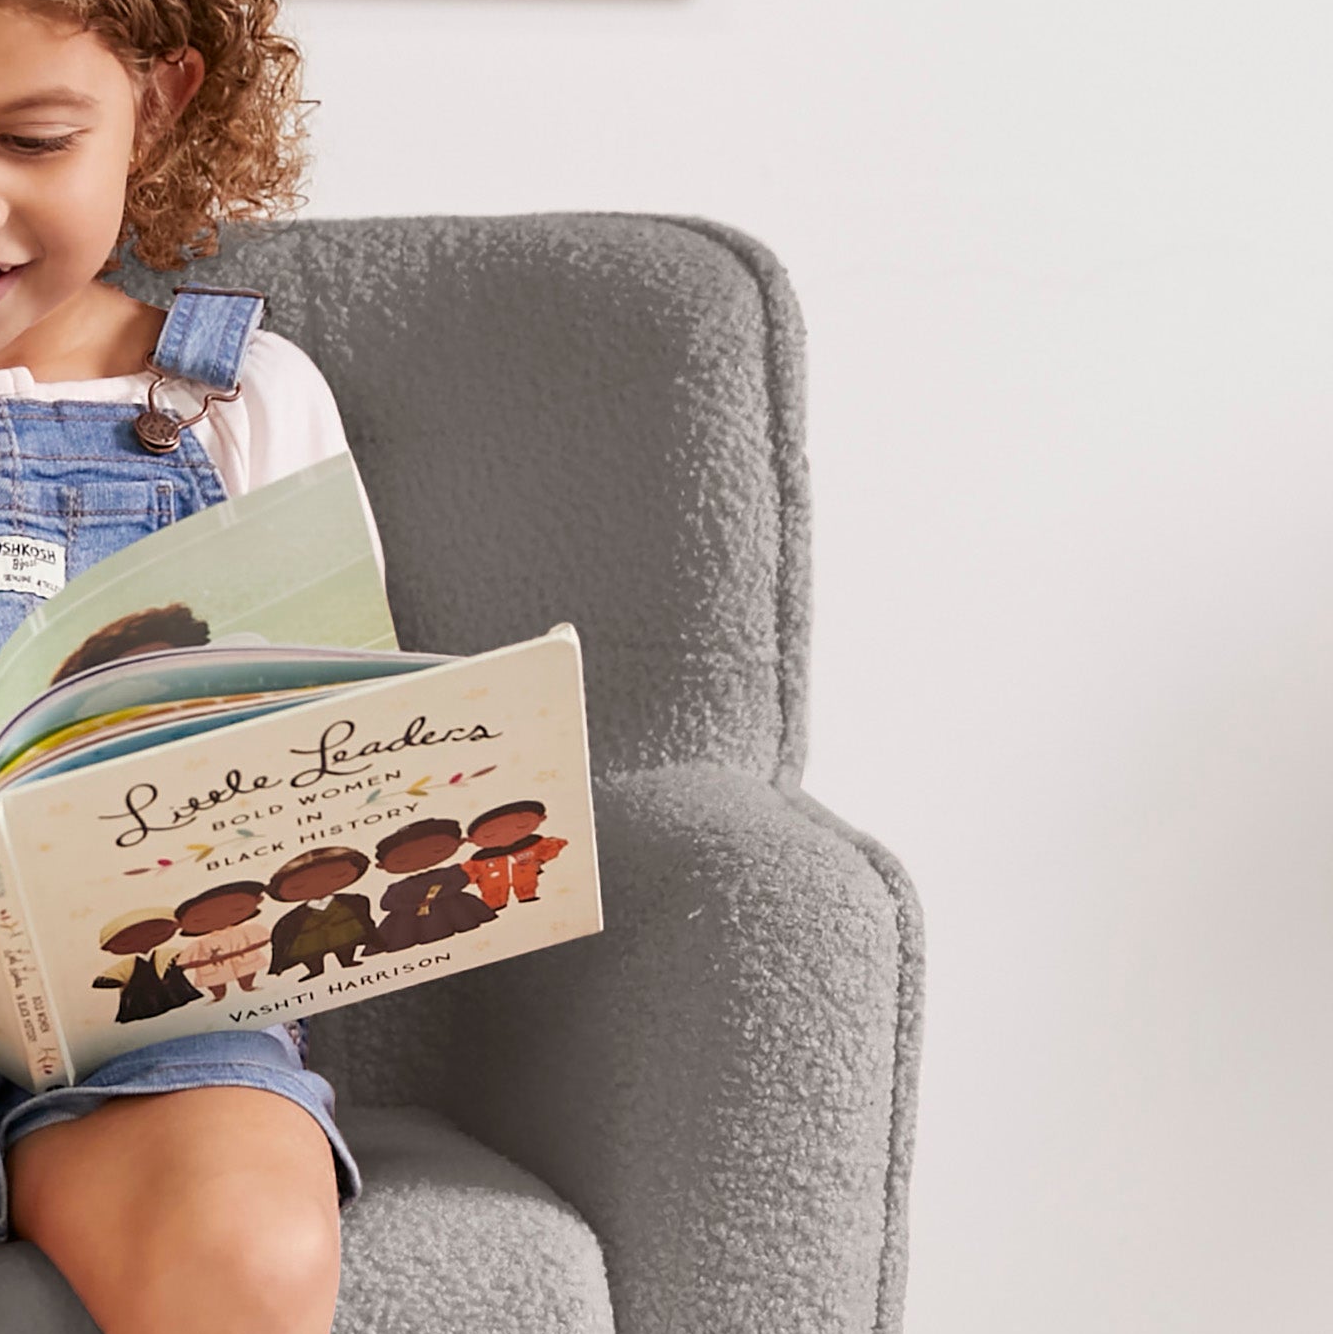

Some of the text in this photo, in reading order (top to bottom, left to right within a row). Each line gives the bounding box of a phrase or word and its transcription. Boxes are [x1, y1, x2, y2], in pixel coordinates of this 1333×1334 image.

[98, 715, 503, 848] Little Leaders
[211, 769, 403, 833] BOLD WOMEN
[206, 802, 420, 872] BLACK HISTORY
[296, 810, 324, 828] IN
[229, 951, 452, 1024] VASHTI HARRISON
